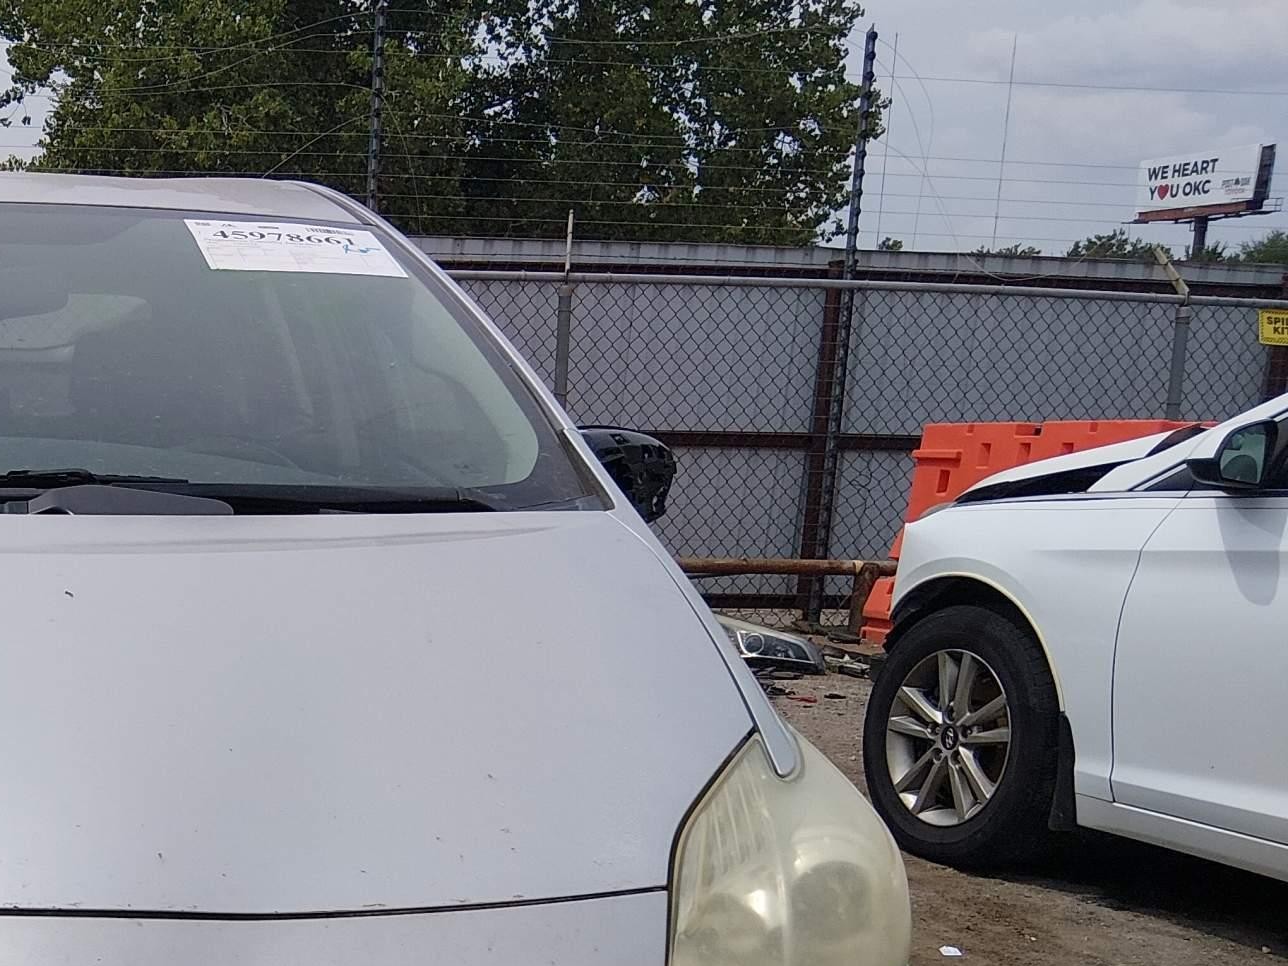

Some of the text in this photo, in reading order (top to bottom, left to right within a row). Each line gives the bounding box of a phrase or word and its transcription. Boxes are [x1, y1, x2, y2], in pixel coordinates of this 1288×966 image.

[1148, 158, 1219, 181] WE HEART
[1182, 180, 1211, 197] OKC
[213, 229, 355, 246] 45978661
